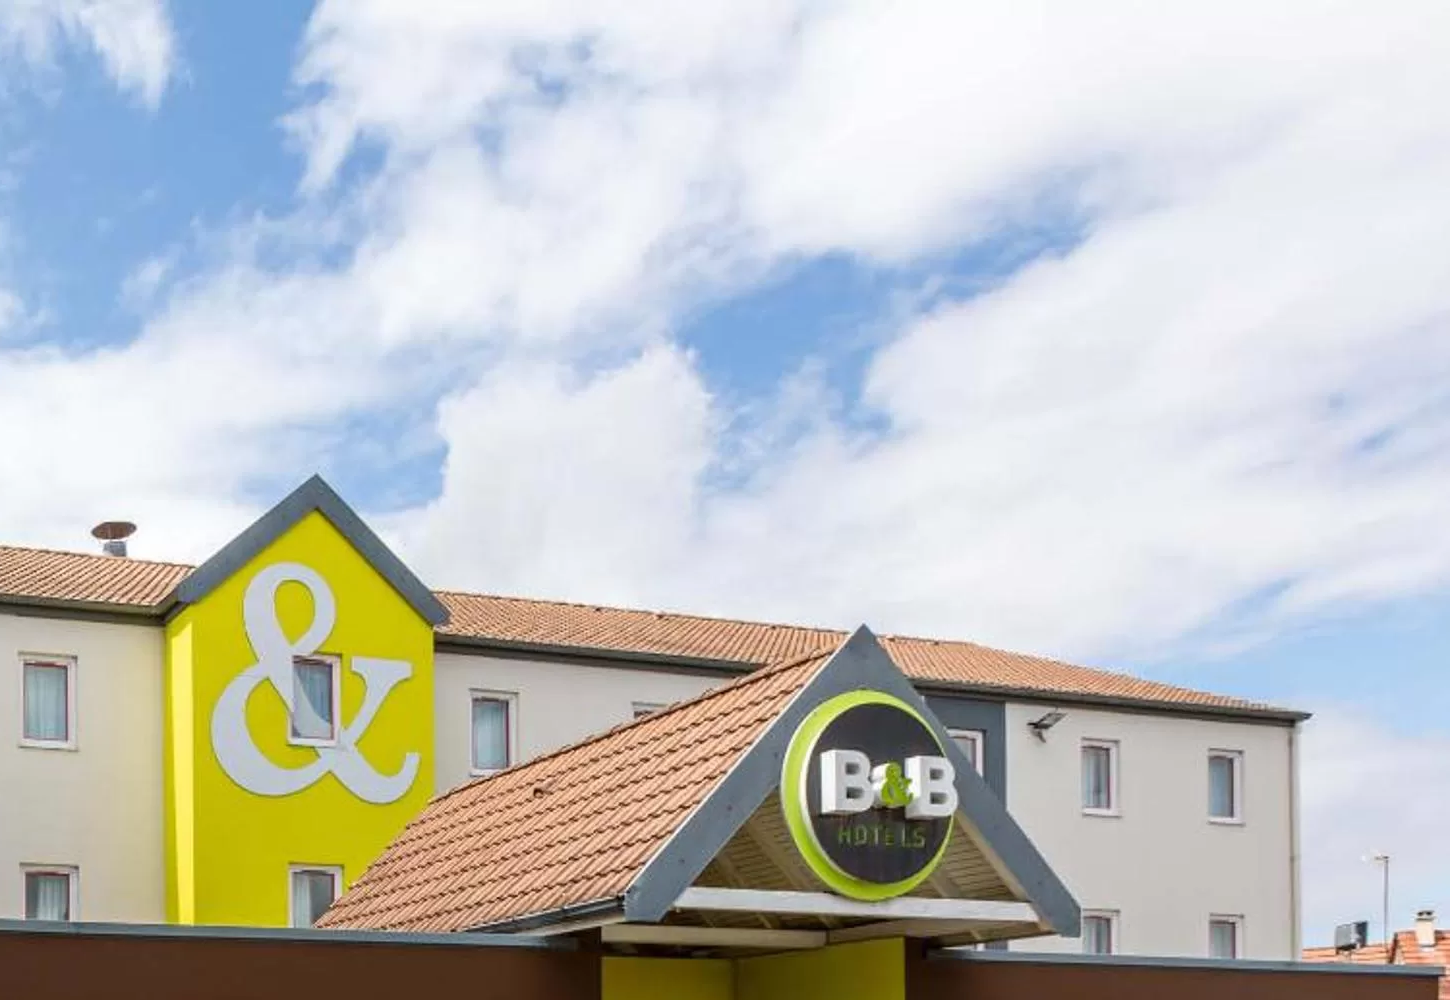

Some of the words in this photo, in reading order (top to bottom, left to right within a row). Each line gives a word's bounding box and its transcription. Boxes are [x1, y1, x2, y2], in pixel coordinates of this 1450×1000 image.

[210, 561, 420, 805] &
[820, 749, 959, 819] B&B
[838, 821, 927, 848] HOTELS
